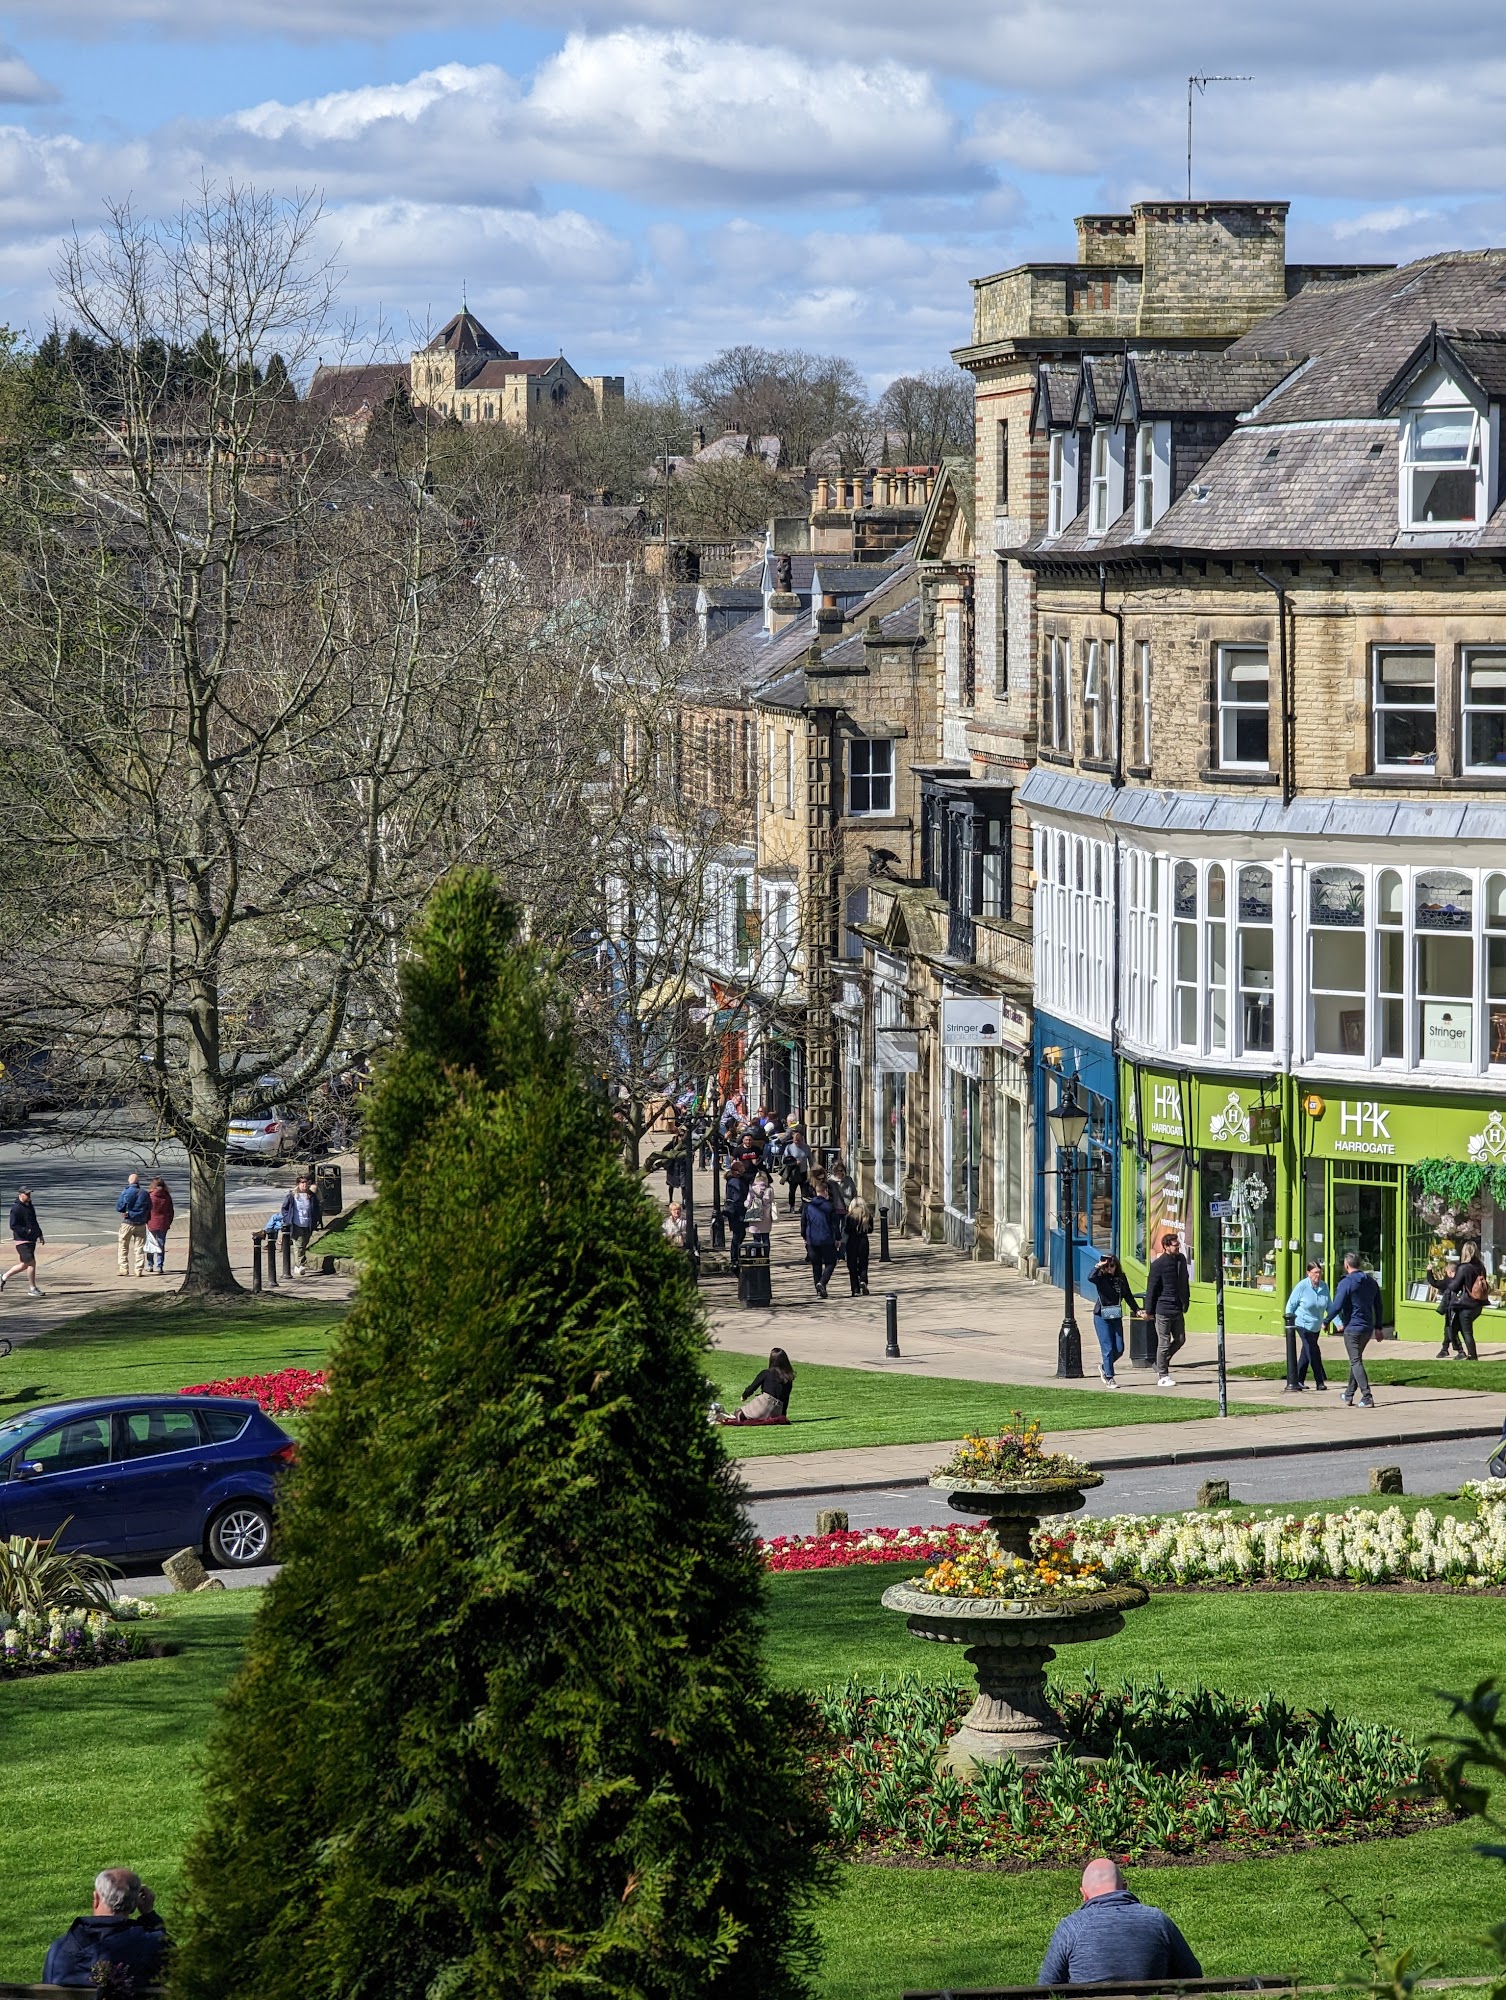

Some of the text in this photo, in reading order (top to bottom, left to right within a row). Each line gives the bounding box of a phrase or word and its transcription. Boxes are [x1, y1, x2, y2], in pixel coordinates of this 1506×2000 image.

[946, 1024, 978, 1033] Stringer
[1429, 1025, 1466, 1040] Stringer
[1151, 1122, 1184, 1137] HARROGATE
[1334, 1140, 1396, 1155] HARROGATE
[1160, 1218, 1186, 1231] remedies
